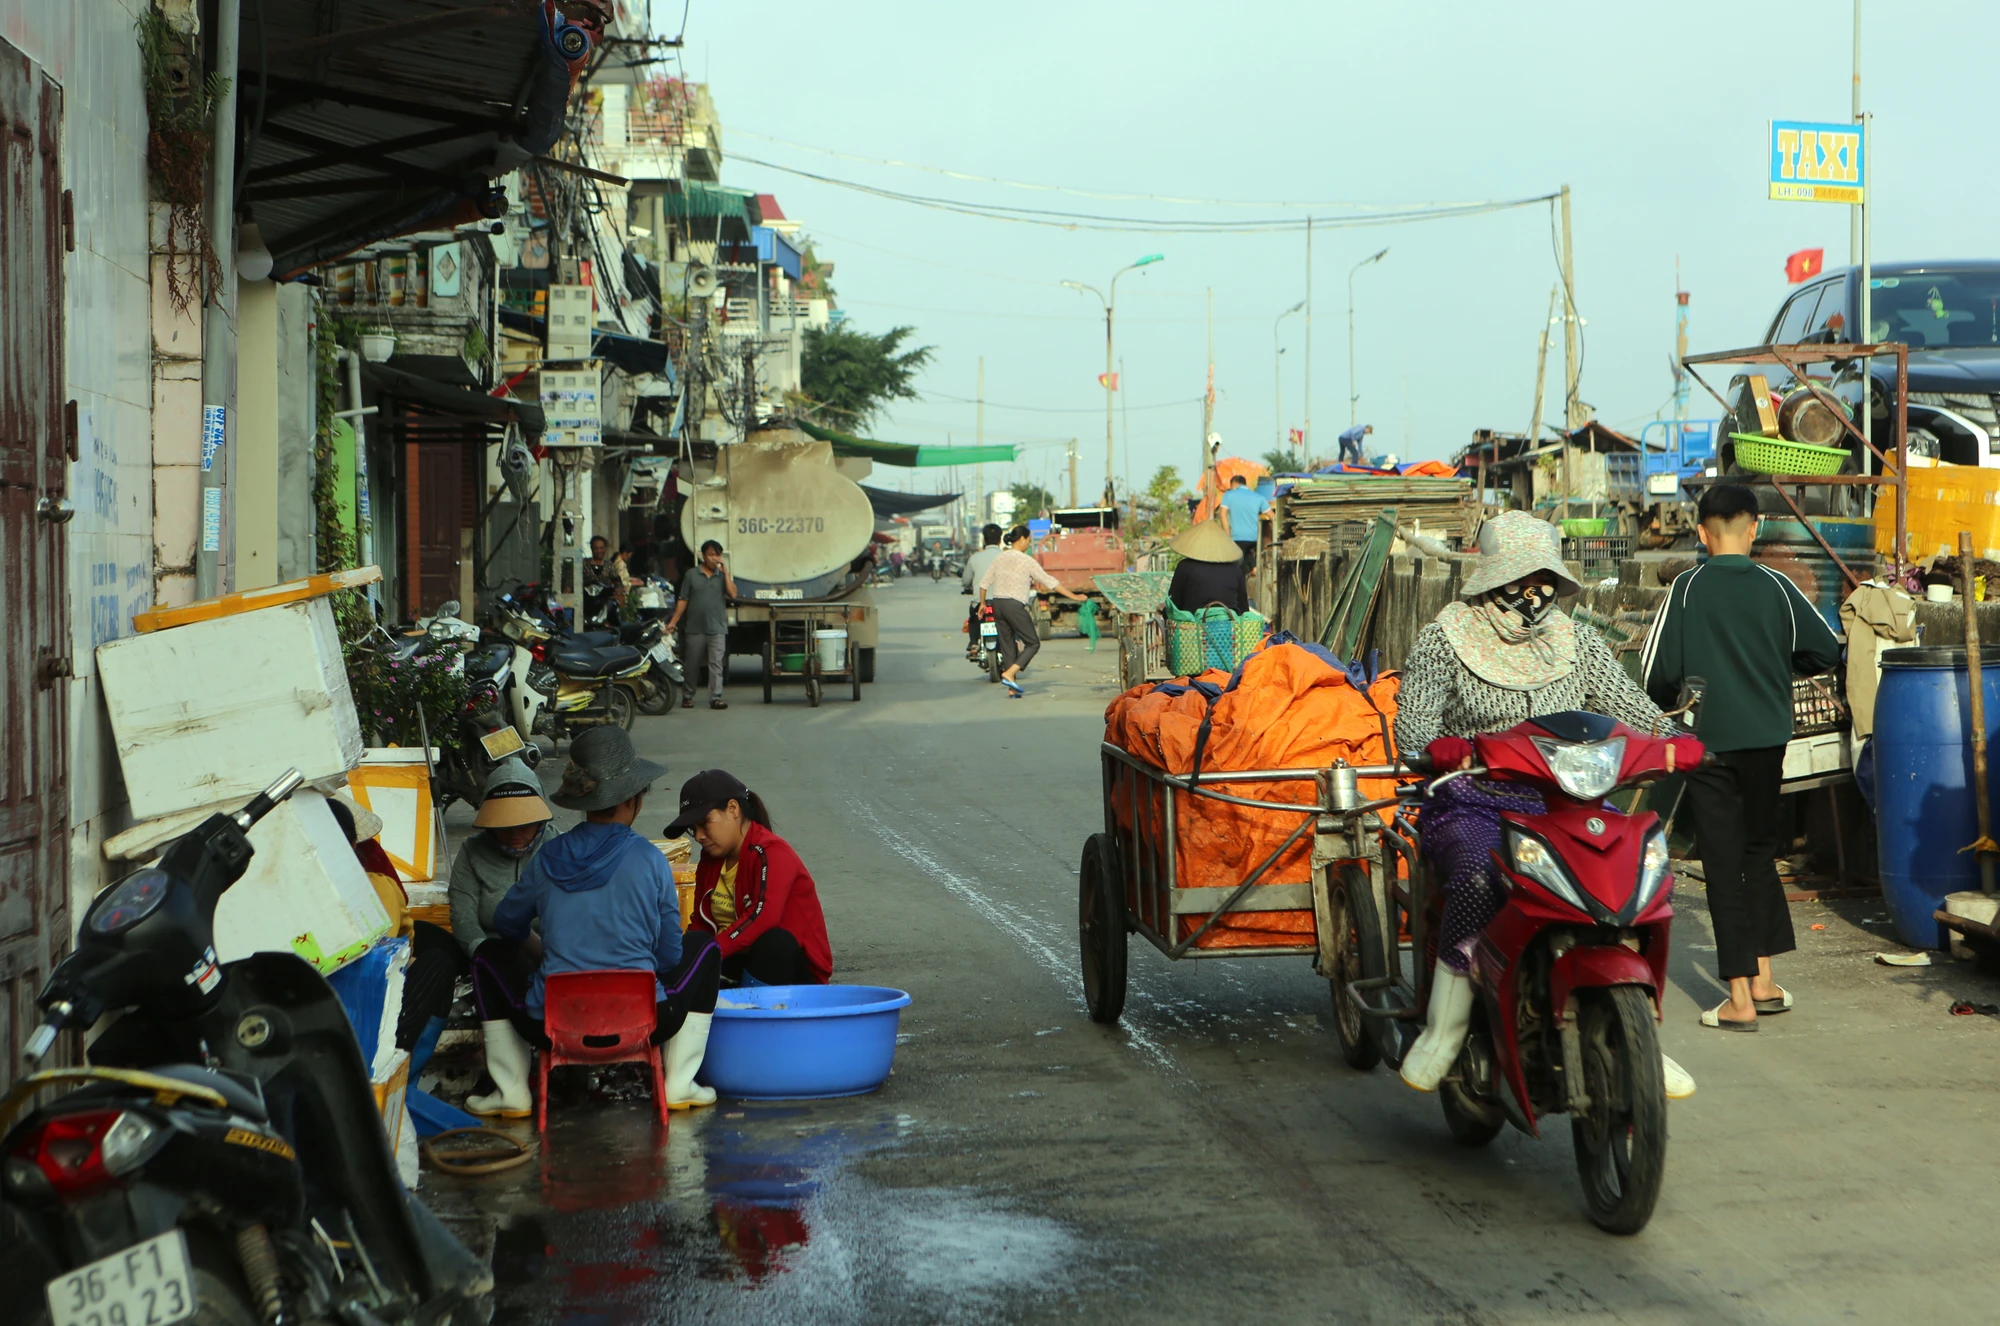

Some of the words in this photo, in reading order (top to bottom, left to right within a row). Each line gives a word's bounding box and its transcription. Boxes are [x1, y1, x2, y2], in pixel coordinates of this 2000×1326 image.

[1778, 128, 1859, 183] TAXI
[1778, 187, 1794, 197] LH:
[738, 516, 825, 534] 36C-22370
[66, 1243, 163, 1313] 36-F1
